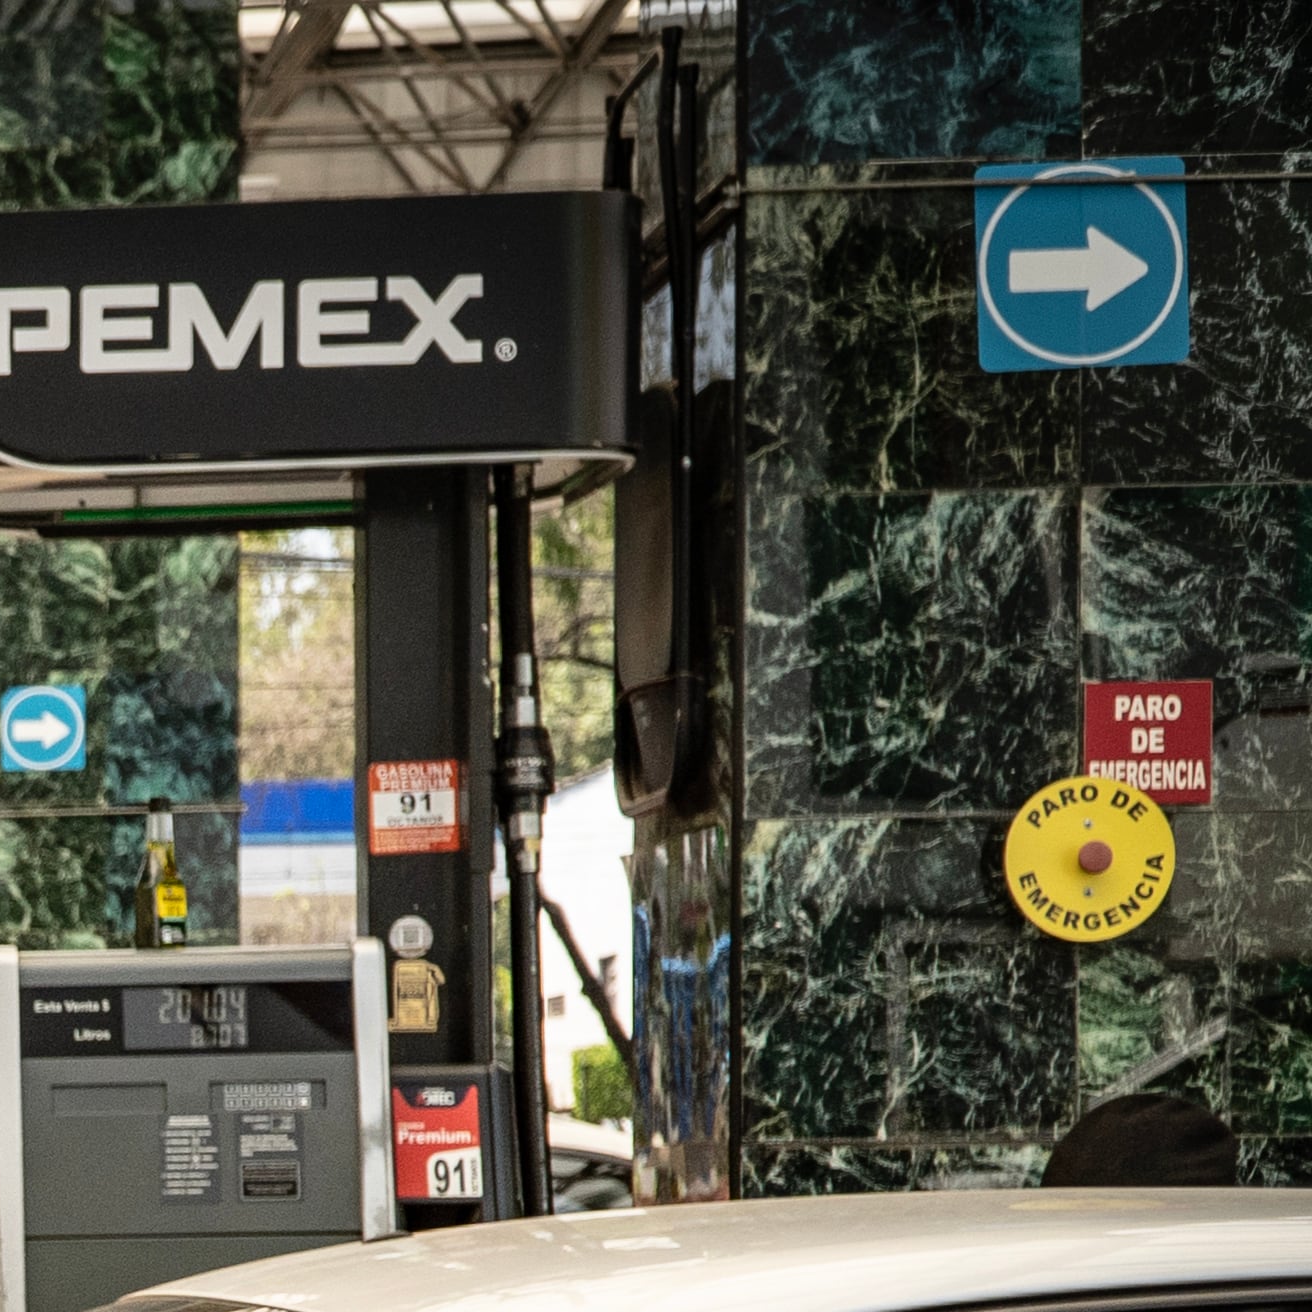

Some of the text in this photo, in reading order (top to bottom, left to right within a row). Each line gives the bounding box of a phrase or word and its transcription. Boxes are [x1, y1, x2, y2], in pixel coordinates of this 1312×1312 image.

[1114, 695, 1182, 721] PARO
[1131, 728, 1165, 753] DE
[376, 761, 453, 780] GASOLINA
[1089, 760, 1206, 790] EMERGENCIA
[379, 779, 450, 791] PREMIUM
[400, 793, 431, 814] 91
[1027, 784, 1149, 829] PARO DE
[1019, 853, 1165, 931] EMERGENCIA
[34, 1000, 62, 1013] Esta
[64, 1000, 100, 1013] Venta
[73, 1028, 112, 1041] Litros
[397, 1127, 472, 1145] Premium
[434, 1159, 466, 1194] 91
